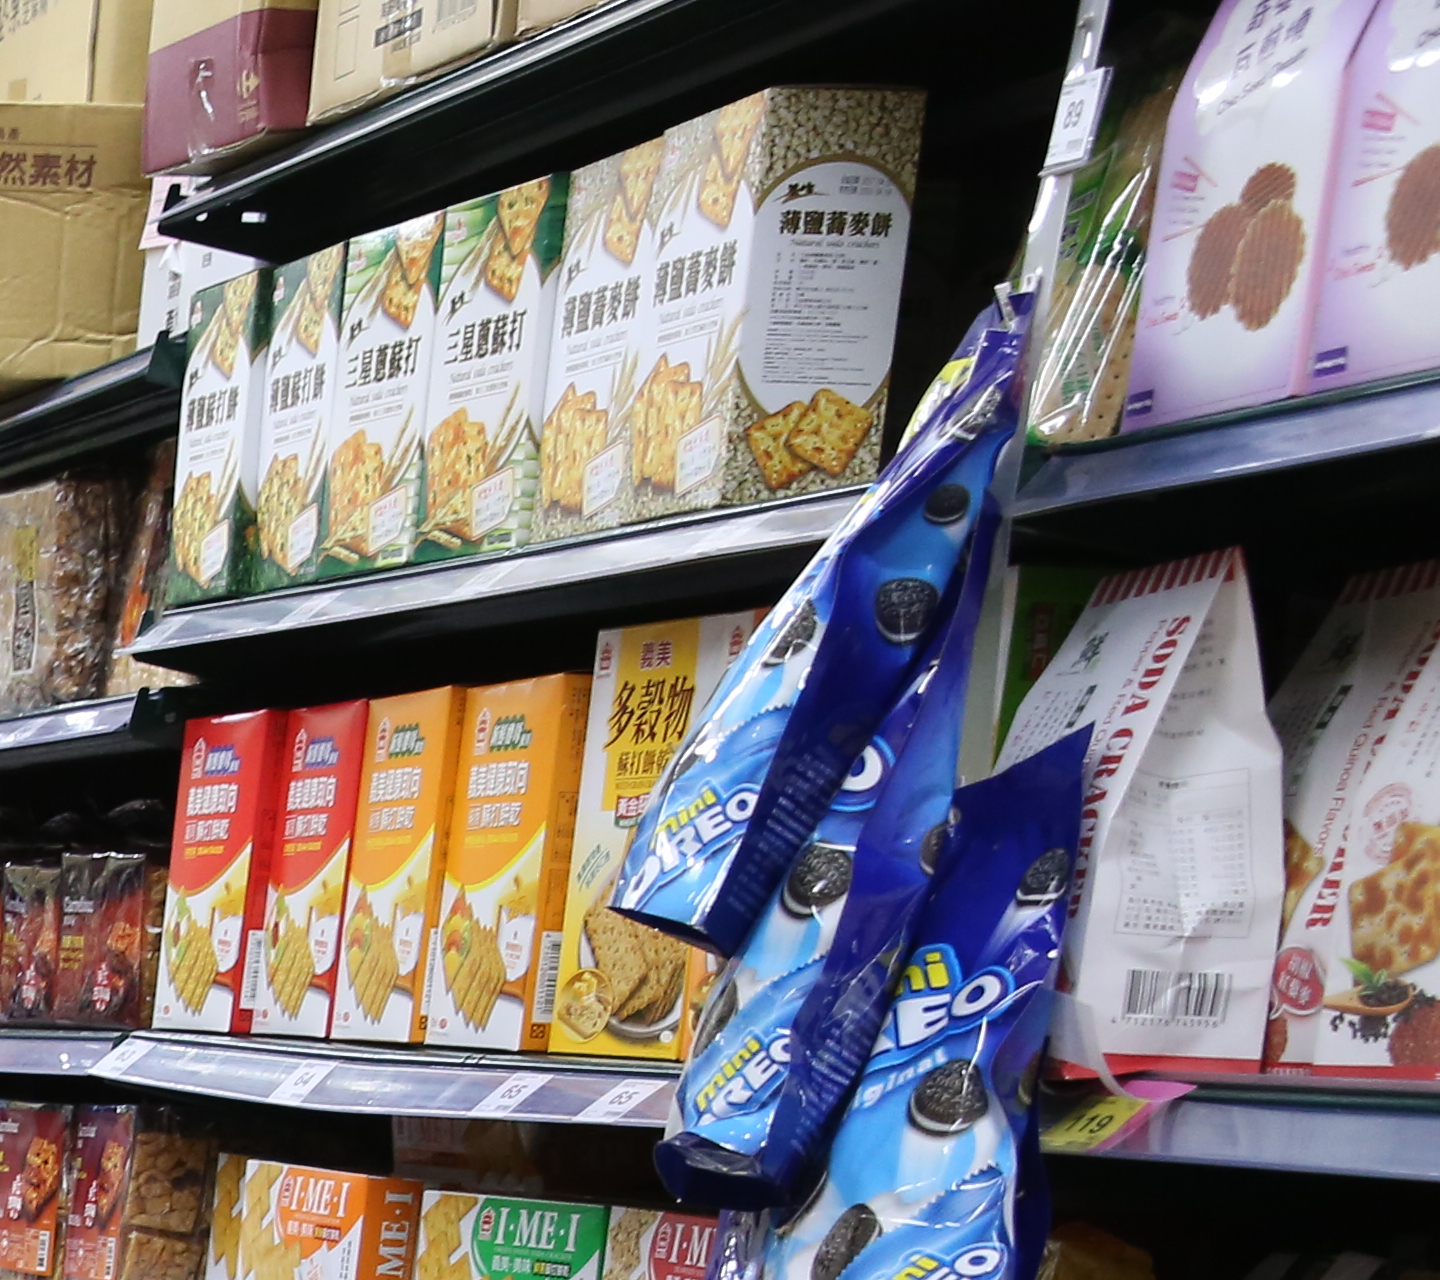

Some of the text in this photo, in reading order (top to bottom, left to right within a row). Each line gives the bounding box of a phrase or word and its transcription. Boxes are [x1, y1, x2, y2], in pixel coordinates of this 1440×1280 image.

[779, 210, 893, 238] 薄鹽蕎麥餅
[608, 676, 696, 743] 多穀物
[649, 789, 717, 848] mini
[502, 1083, 525, 1102] 65
[697, 1037, 760, 1112] mini
[610, 1090, 635, 1109] 65
[1067, 1111, 1112, 1137] 119
[494, 1207, 580, 1252] I·ME·I
